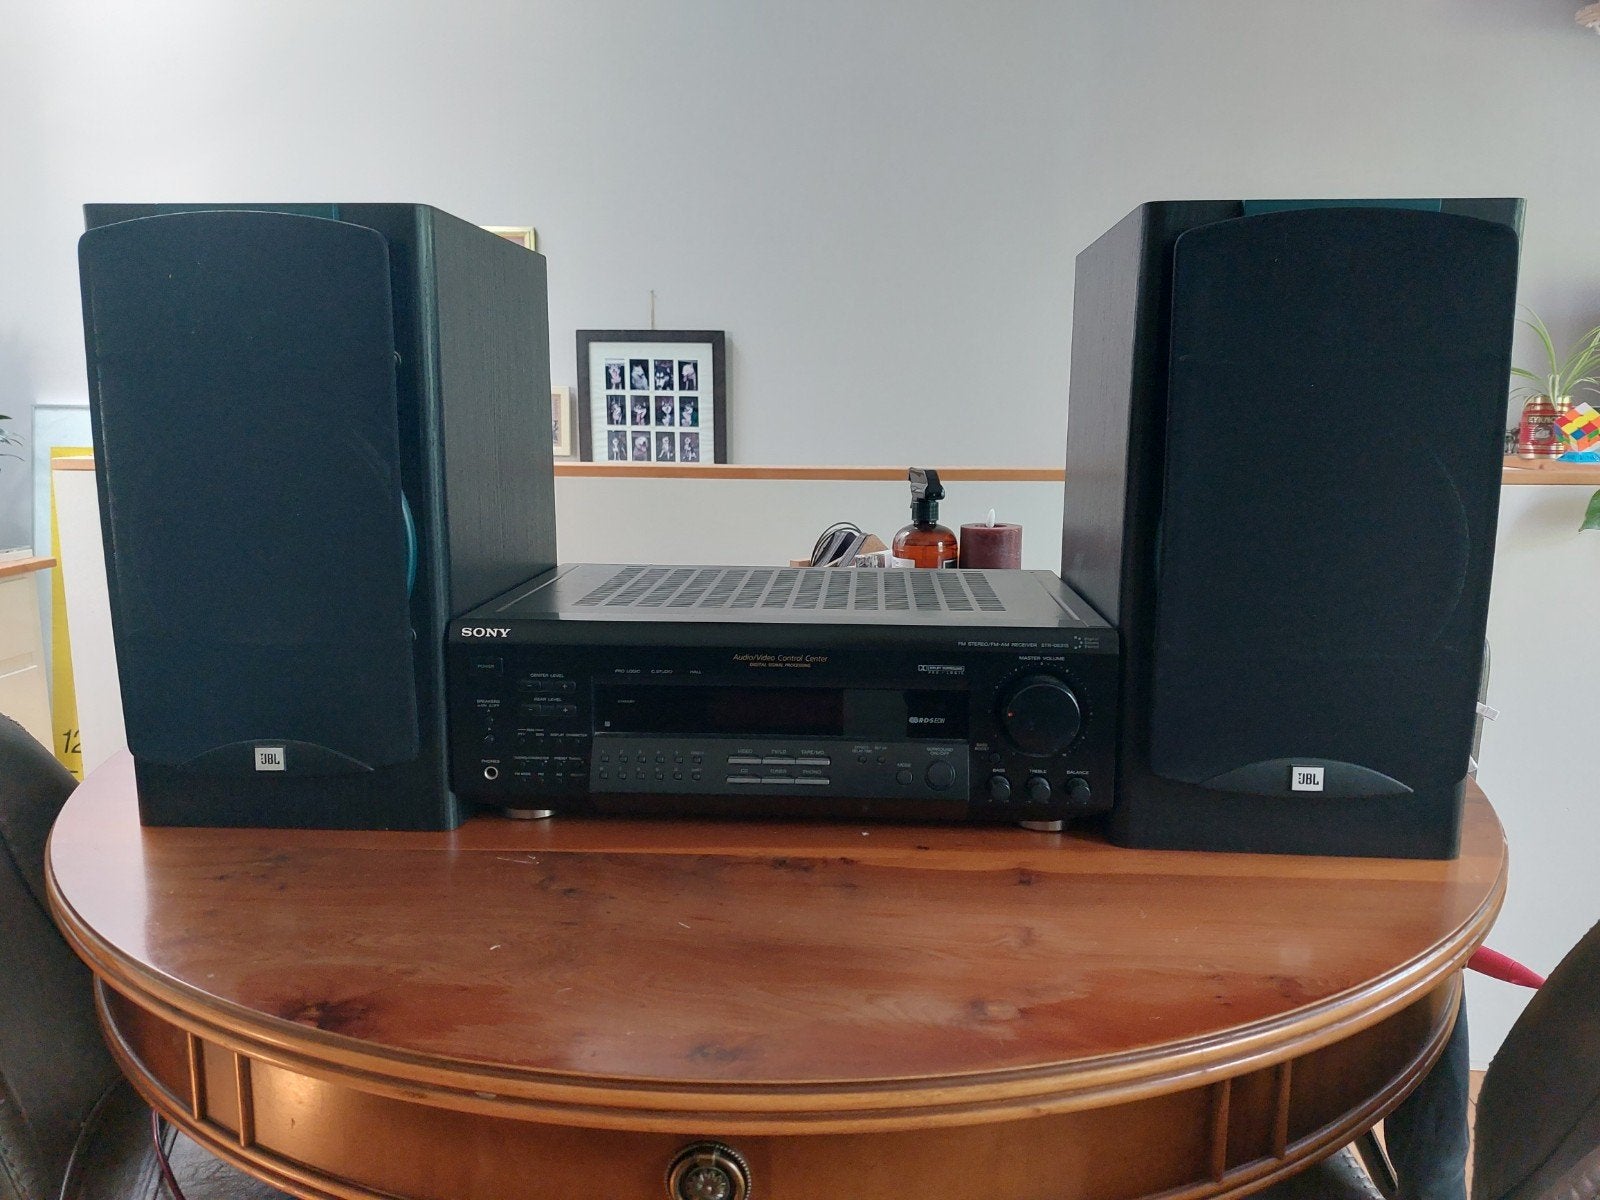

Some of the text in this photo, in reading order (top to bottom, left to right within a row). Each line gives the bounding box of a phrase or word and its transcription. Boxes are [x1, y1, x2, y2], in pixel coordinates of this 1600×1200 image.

[461, 627, 511, 638] SONY
[733, 653, 829, 663] Audio/Video Control Center
[260, 753, 280, 765] JBL
[1297, 772, 1320, 786] JBL
